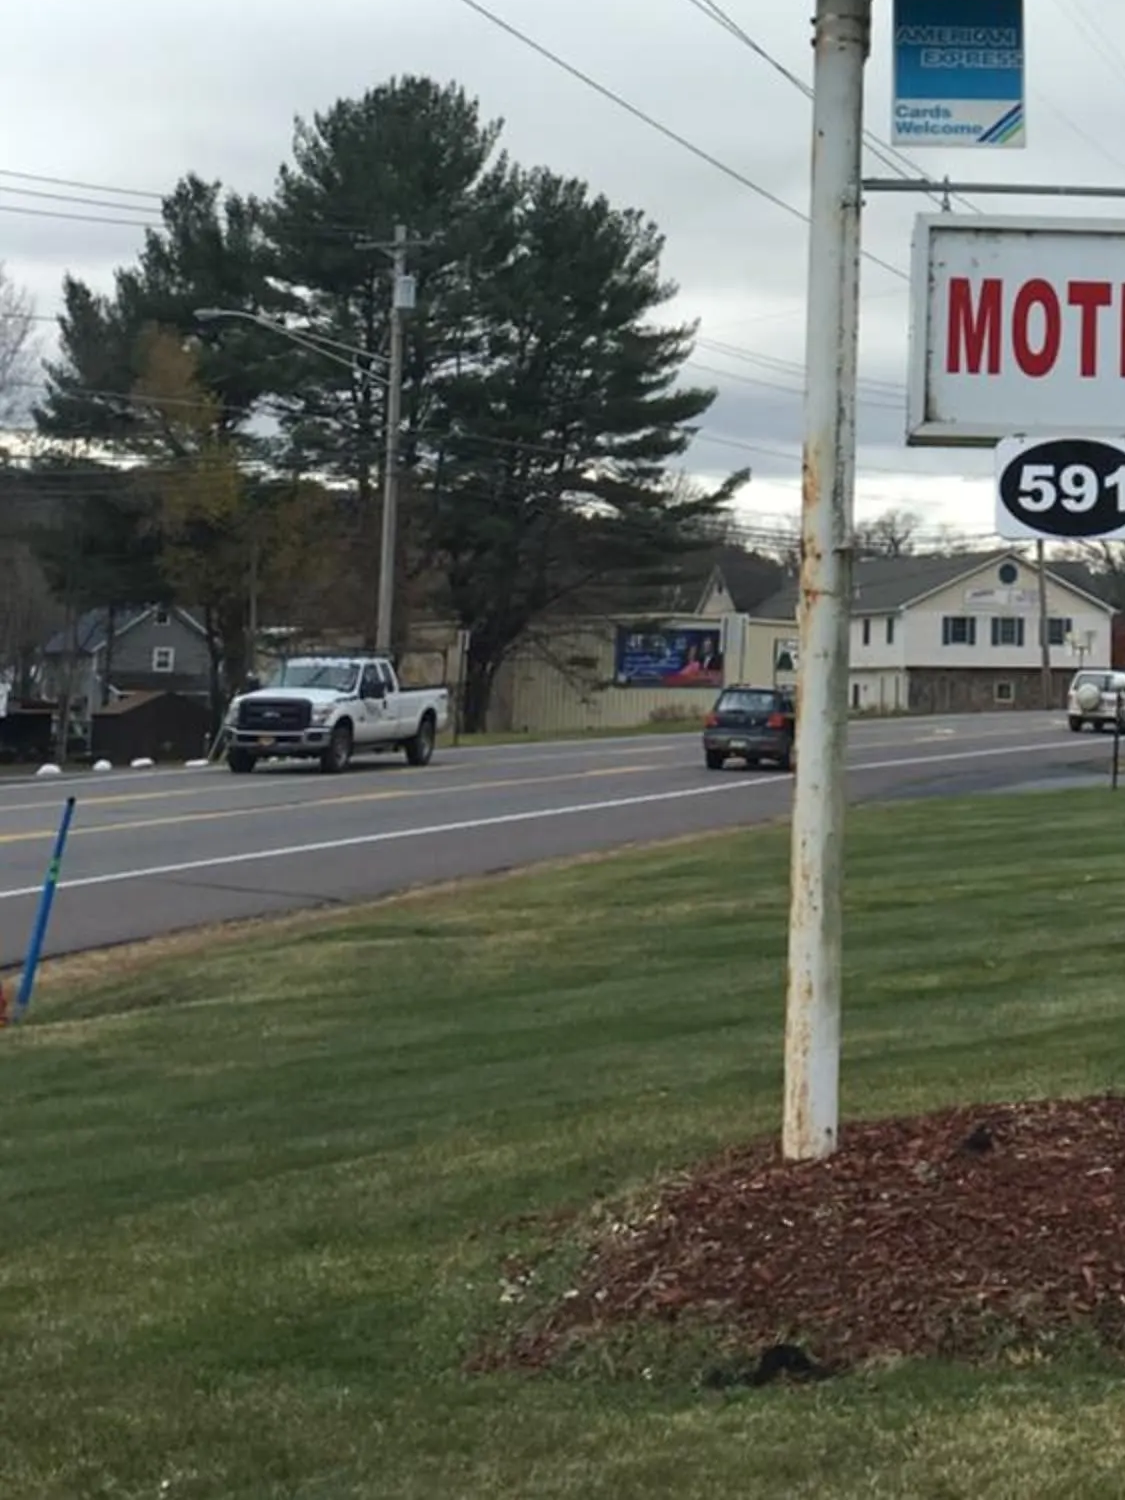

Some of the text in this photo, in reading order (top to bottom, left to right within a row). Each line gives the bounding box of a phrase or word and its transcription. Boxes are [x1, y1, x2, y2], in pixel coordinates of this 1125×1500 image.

[896, 25, 1016, 47] AMERICAN
[920, 48, 1023, 68] EXPRESS
[895, 105, 952, 118] Cards
[896, 120, 984, 134] Welcome
